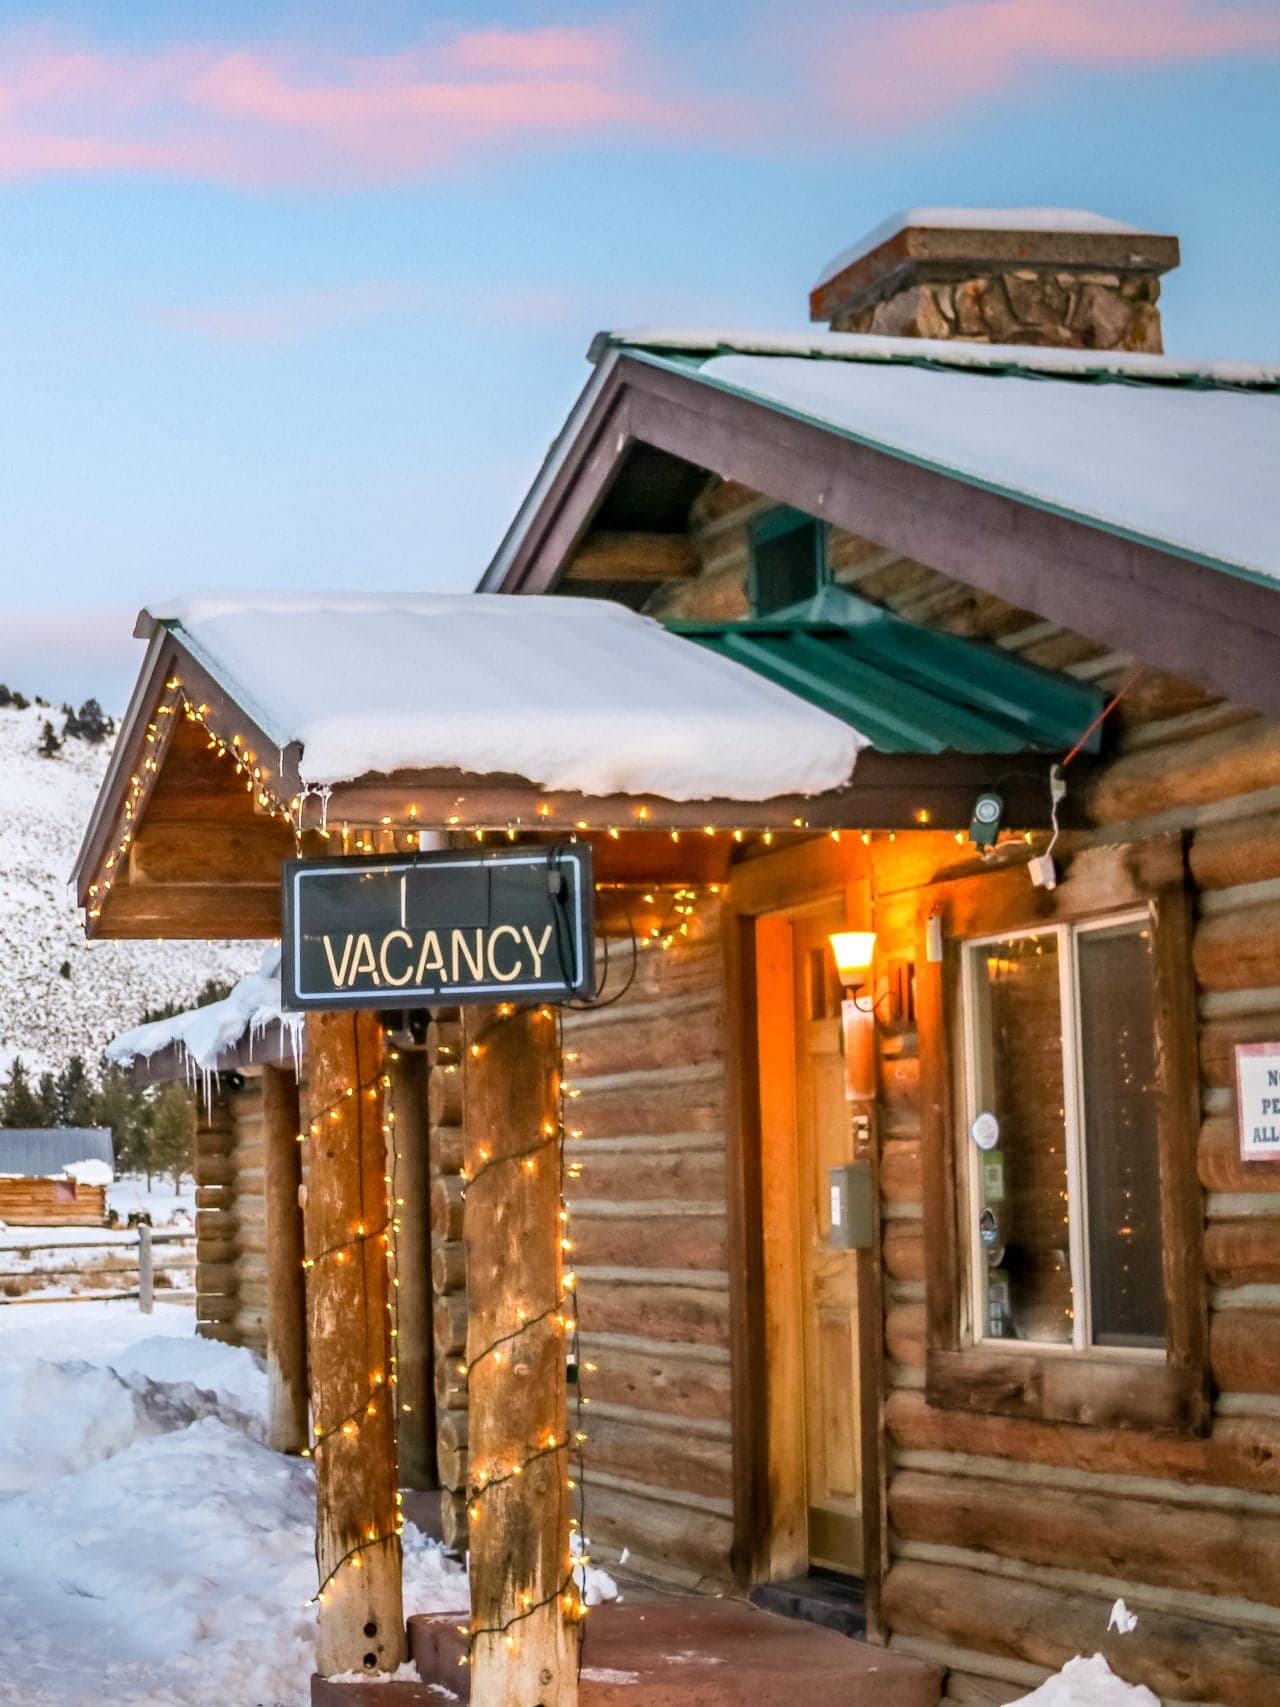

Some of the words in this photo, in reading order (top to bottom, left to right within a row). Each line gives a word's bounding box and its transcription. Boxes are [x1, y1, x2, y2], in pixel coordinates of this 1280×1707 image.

[322, 924, 553, 988] VACANCY
[1267, 1070, 1280, 1086] N
[1252, 1126, 1280, 1143] ALL
